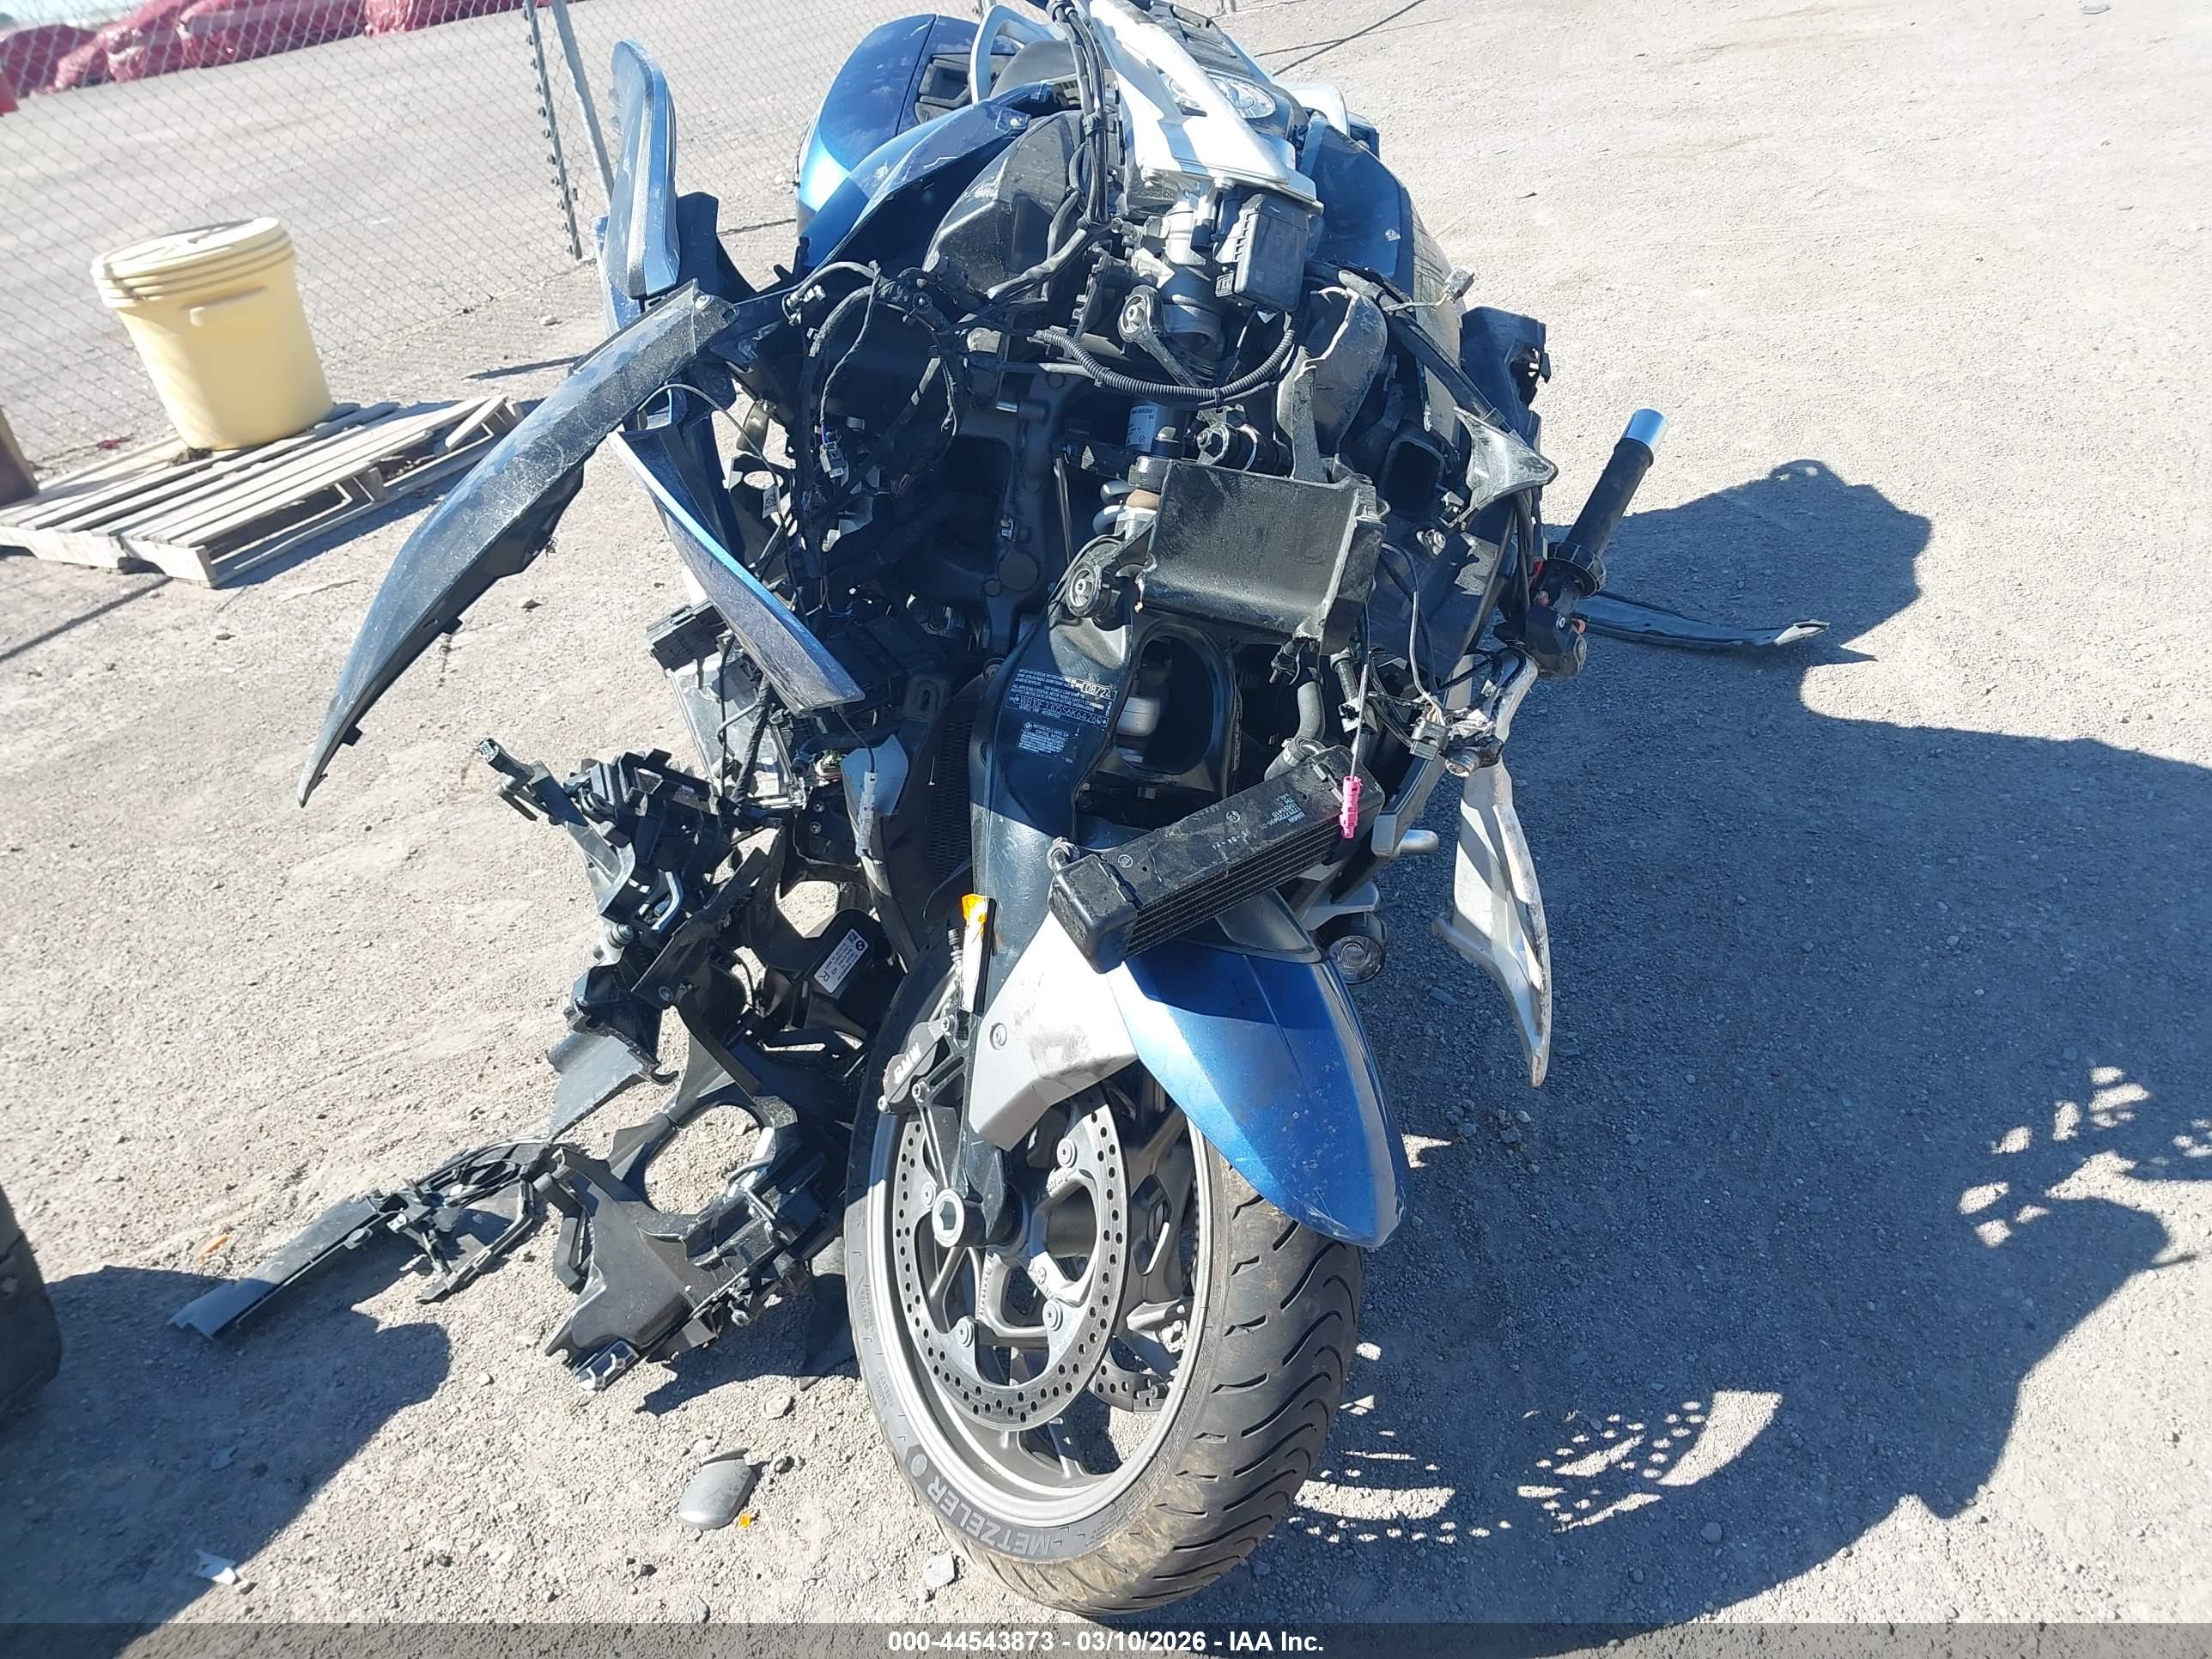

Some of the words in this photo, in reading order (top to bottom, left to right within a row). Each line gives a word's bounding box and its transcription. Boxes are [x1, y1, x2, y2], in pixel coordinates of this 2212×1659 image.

[1084, 684, 1112, 697] 08/24
[1287, 811, 1305, 823] BMW
[818, 969, 830, 981] R
[893, 1041, 921, 1084] BMW
[926, 1474, 1054, 1556] METZELER
